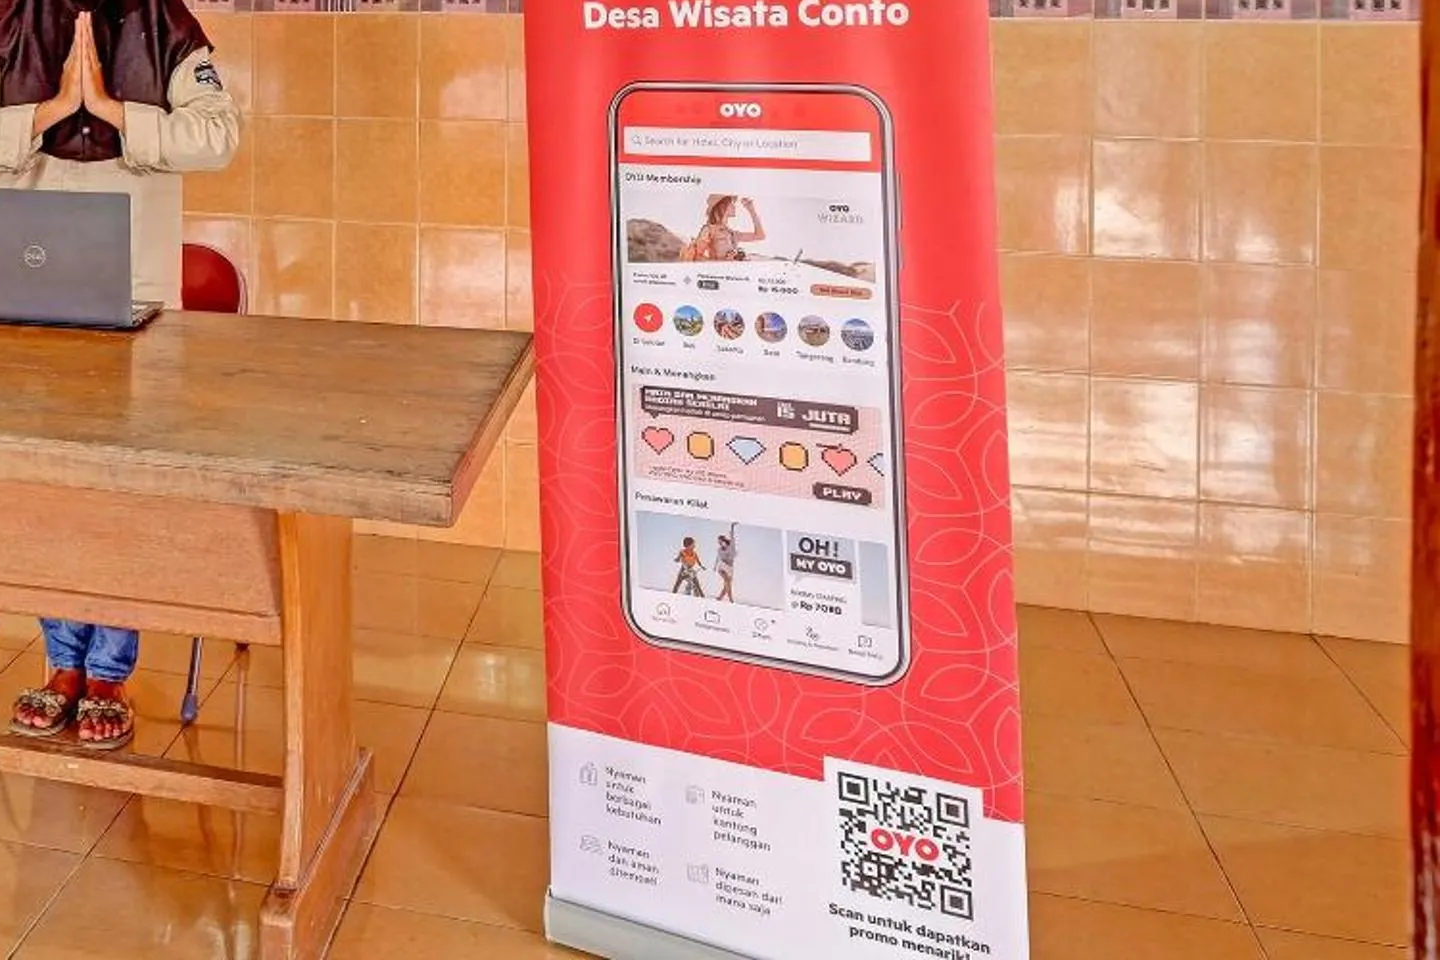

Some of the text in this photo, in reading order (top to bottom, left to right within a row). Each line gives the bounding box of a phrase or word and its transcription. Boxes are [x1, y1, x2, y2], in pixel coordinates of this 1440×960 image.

[583, 1, 660, 30] Desa
[669, 0, 788, 29] Wisata
[720, 102, 761, 118] OYO
[799, 537, 838, 557] OH!
[818, 562, 846, 575] OYO
[714, 831, 771, 852] pelanggan
[871, 828, 940, 861] OYO
[715, 867, 760, 886] Nyaman
[828, 902, 991, 954] Scan untuk dapatkan
[849, 926, 898, 946] promo
